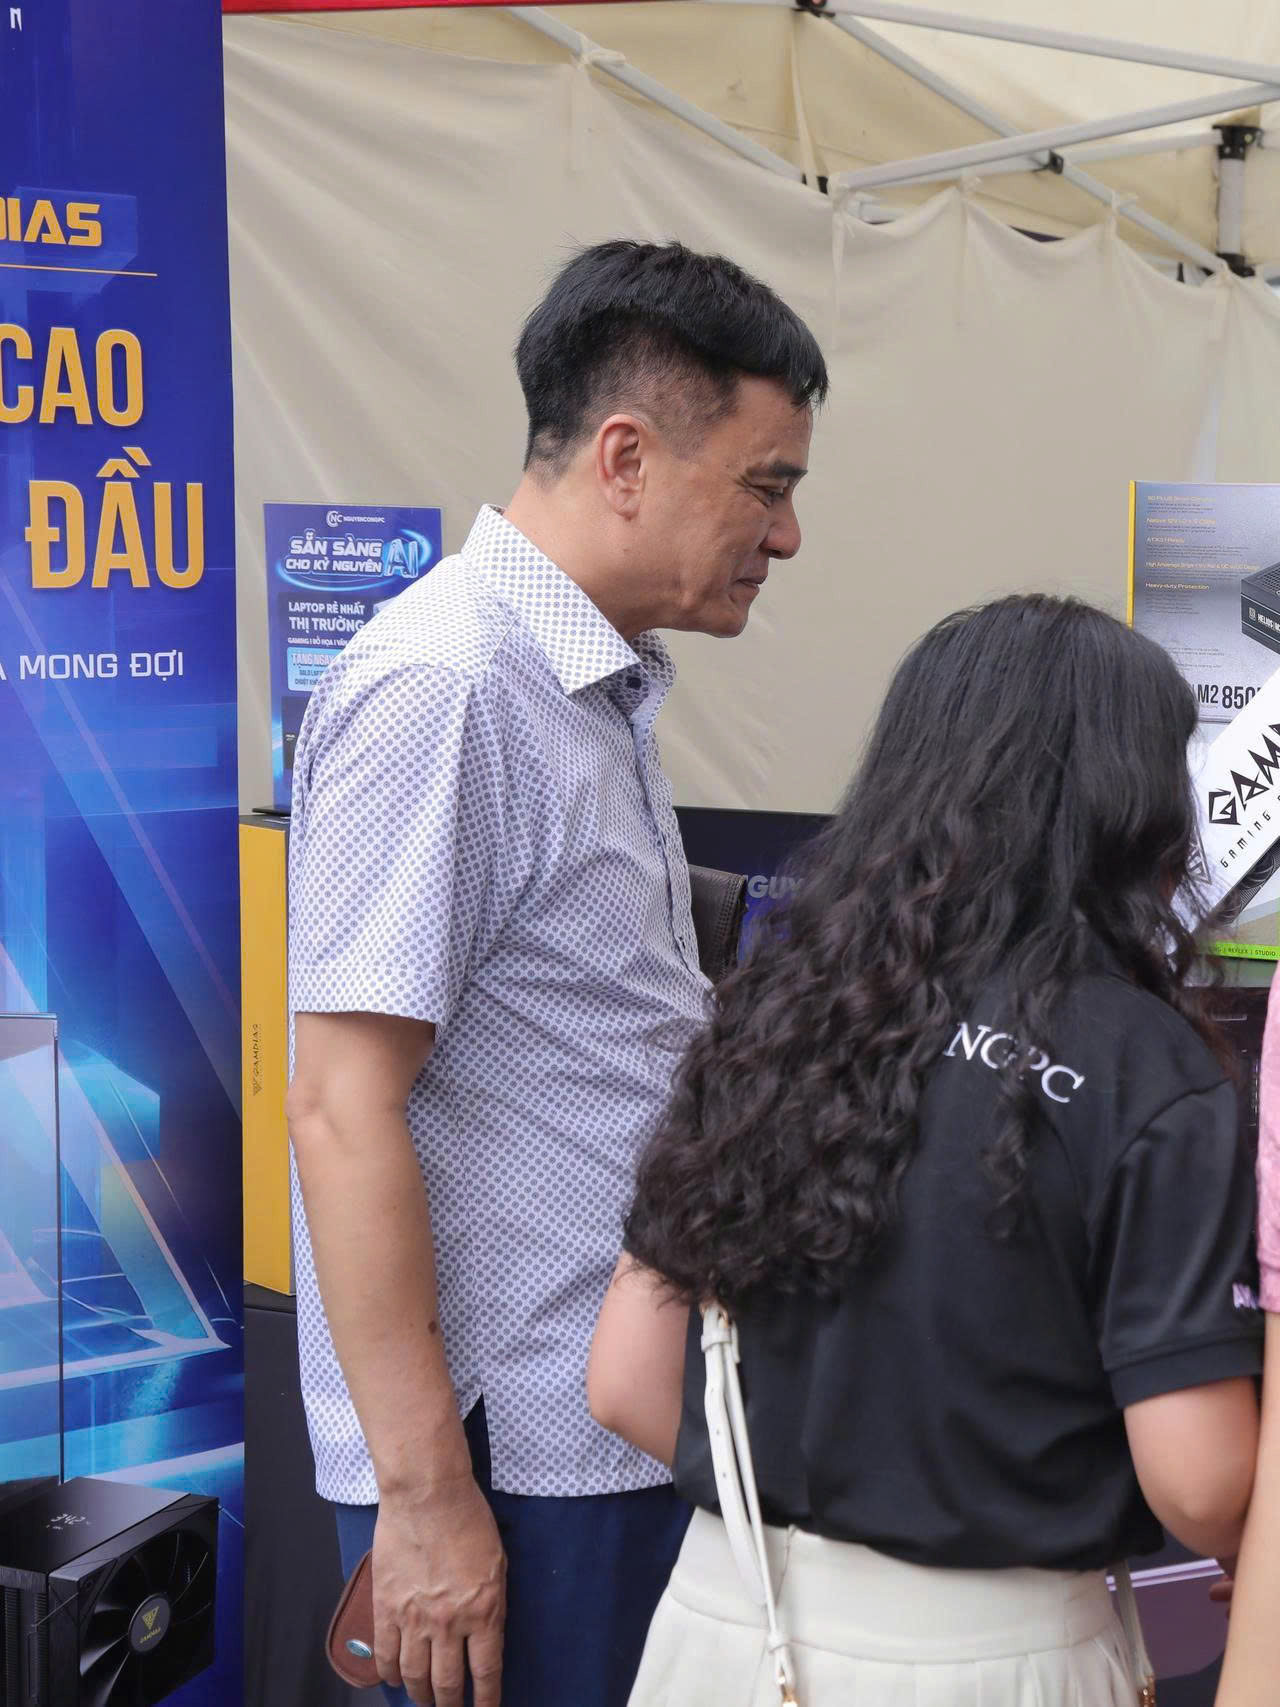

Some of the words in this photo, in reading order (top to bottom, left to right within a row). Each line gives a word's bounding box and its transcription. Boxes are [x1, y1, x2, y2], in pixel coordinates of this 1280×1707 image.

[0, 197, 102, 247] IAS
[0, 323, 144, 427] CAO
[24, 446, 204, 589] ĐẦU
[332, 536, 382, 557] SÀNG
[286, 559, 310, 570] CHO
[332, 558, 382, 573] NGUYÊN
[288, 601, 325, 612] LAPTOP
[288, 616, 310, 634] THỊ
[20, 653, 118, 680] MONG
[129, 649, 184, 682] ĐỢI
[1197, 684, 1219, 704] M2
[1219, 810, 1272, 869] GAMING
[1254, 949, 1276, 957] STUDIO
